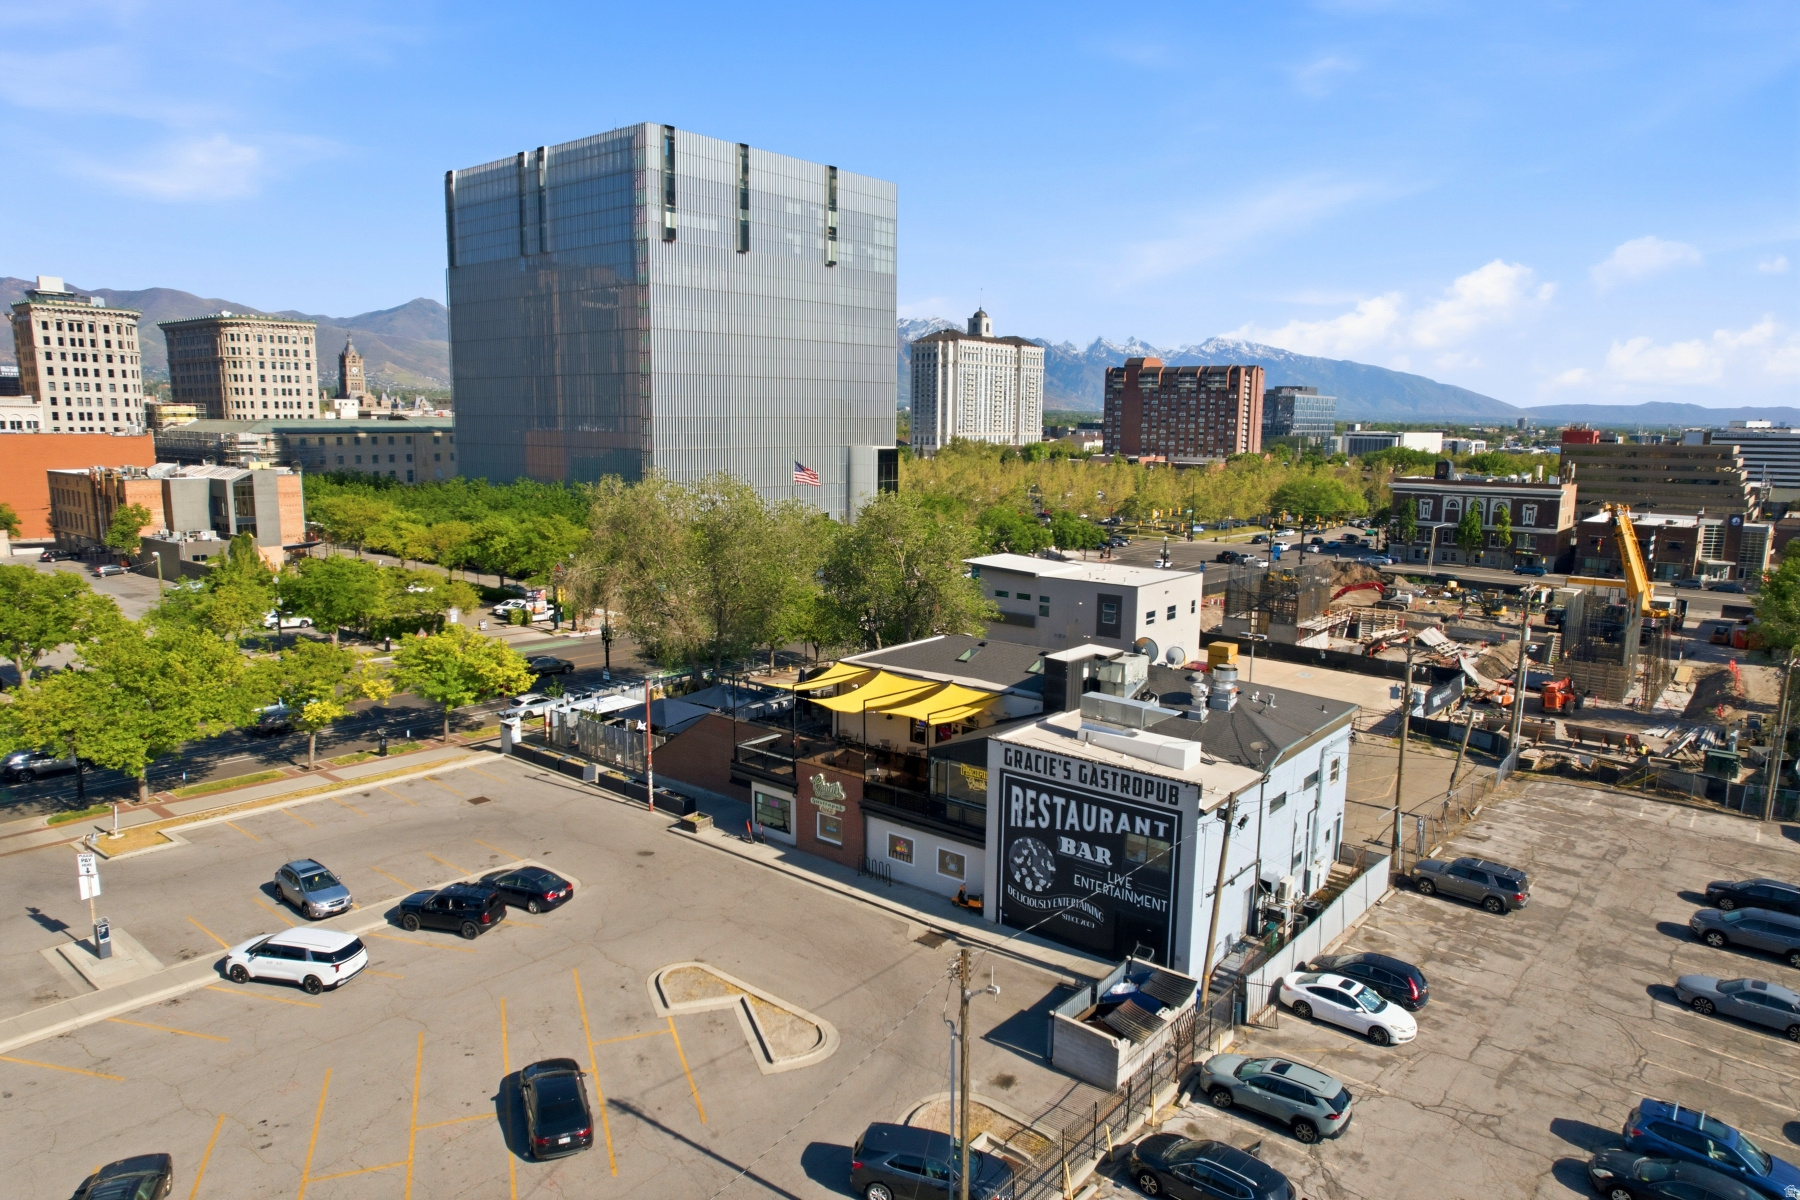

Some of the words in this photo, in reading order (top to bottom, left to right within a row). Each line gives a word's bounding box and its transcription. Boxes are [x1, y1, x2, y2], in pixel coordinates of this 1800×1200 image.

[1004, 747, 1071, 780] GRACIE'S
[1078, 764, 1180, 806] GASTROPUB
[1010, 784, 1170, 837] RESTAURANT
[1058, 836, 1113, 866] BAR
[1073, 873, 1168, 913] ENTERTAINMENT
[1107, 871, 1133, 890] LIVE
[1007, 884, 1052, 909] DELICIOUSLY
[1052, 897, 1105, 923] ENTERTAINING
